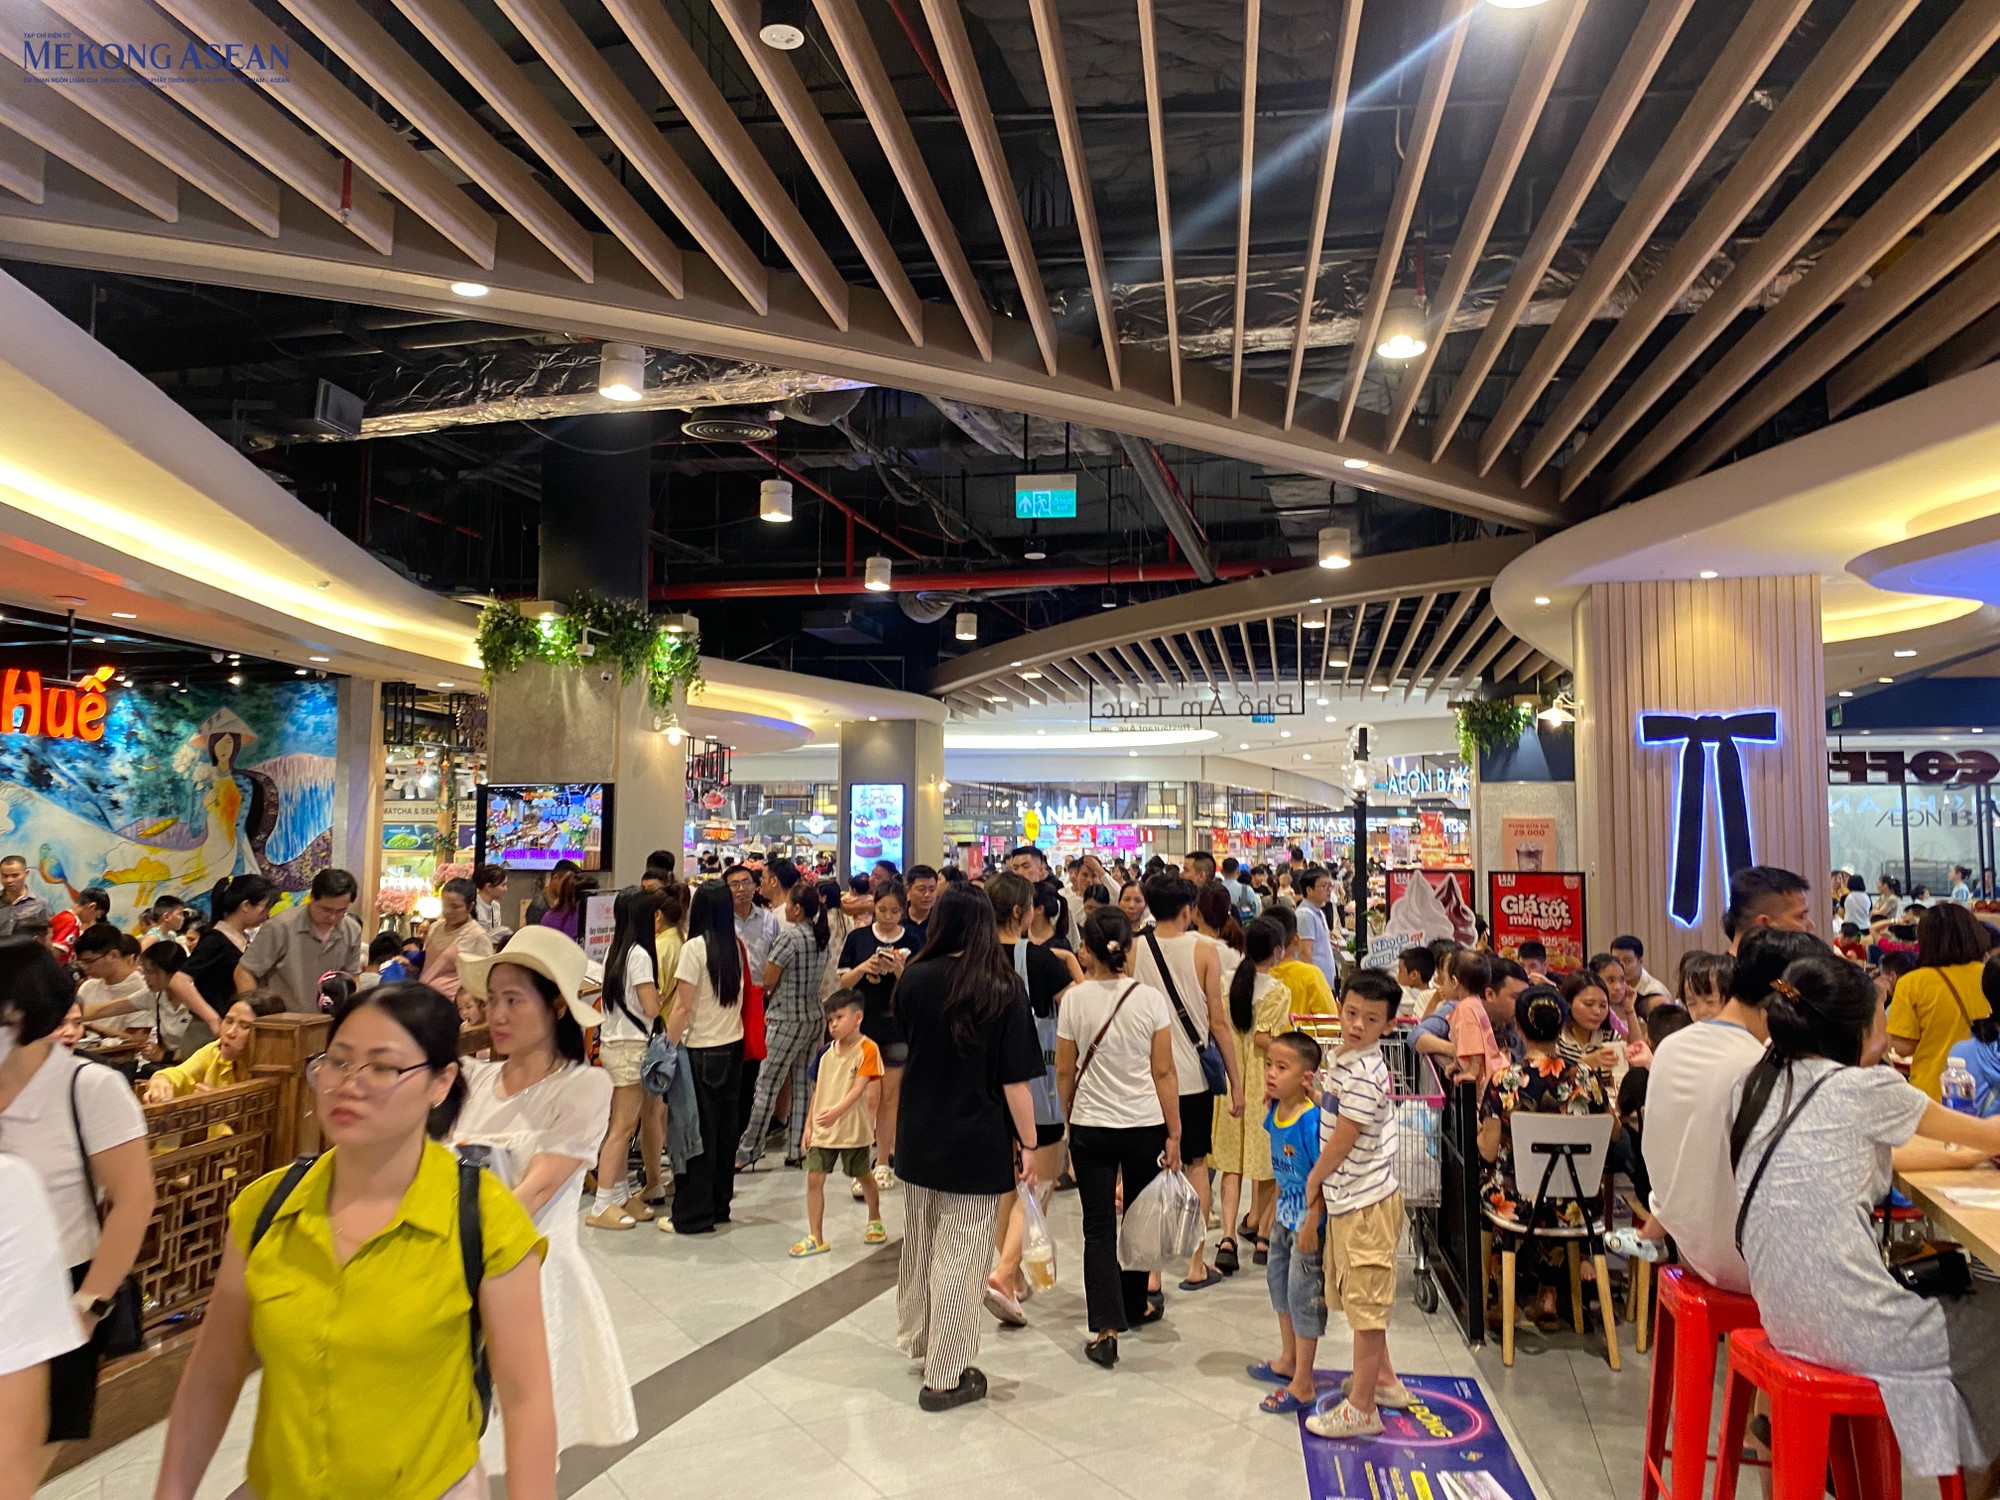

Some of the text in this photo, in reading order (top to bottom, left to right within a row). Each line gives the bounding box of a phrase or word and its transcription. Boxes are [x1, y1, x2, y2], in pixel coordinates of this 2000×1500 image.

[1, 666, 115, 742] Huế
[1388, 769, 1433, 796] AEON
[1513, 829, 1545, 837] 29.000
[1501, 893, 1570, 918] Giá tốt
